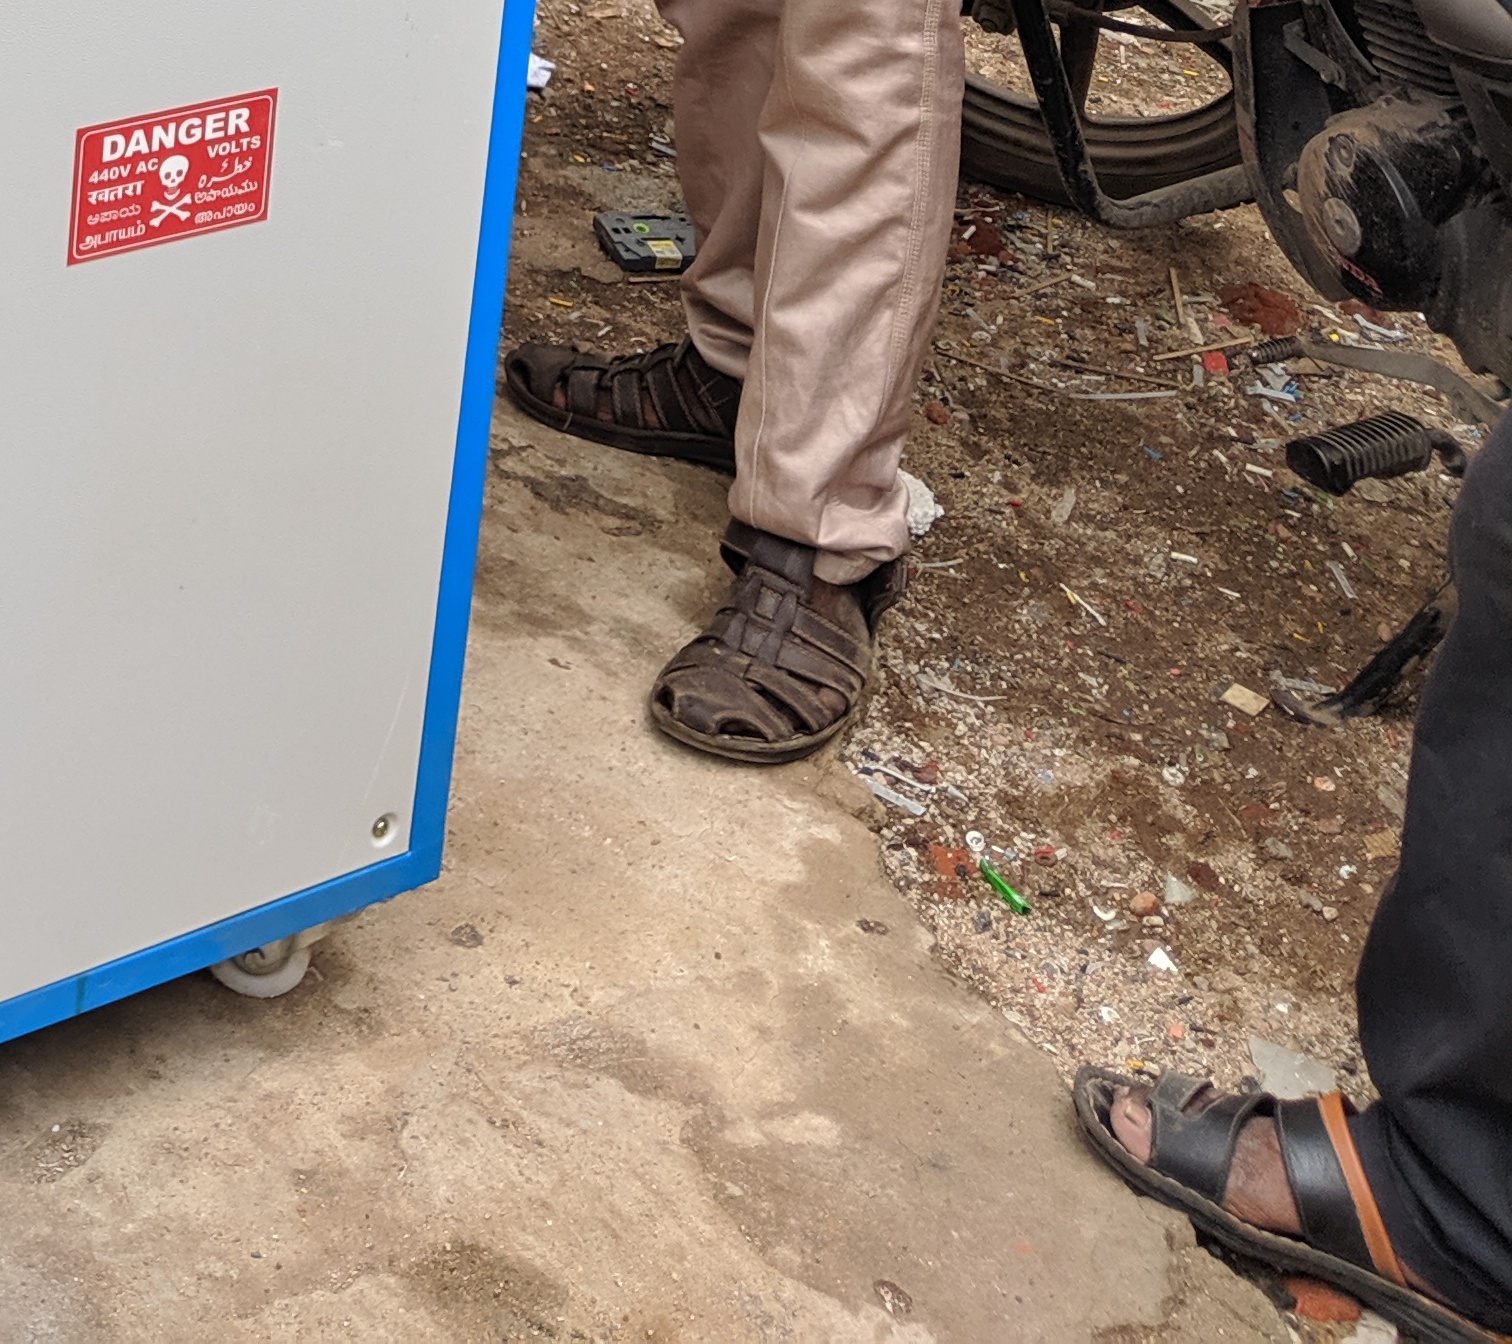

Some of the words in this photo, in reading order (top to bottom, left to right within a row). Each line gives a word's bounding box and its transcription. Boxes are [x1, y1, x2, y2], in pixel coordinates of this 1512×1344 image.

[88, 164, 132, 184] 440V
[135, 158, 159, 175] AC
[207, 135, 261, 158] VOLTS
[102, 107, 251, 162] DANGER
